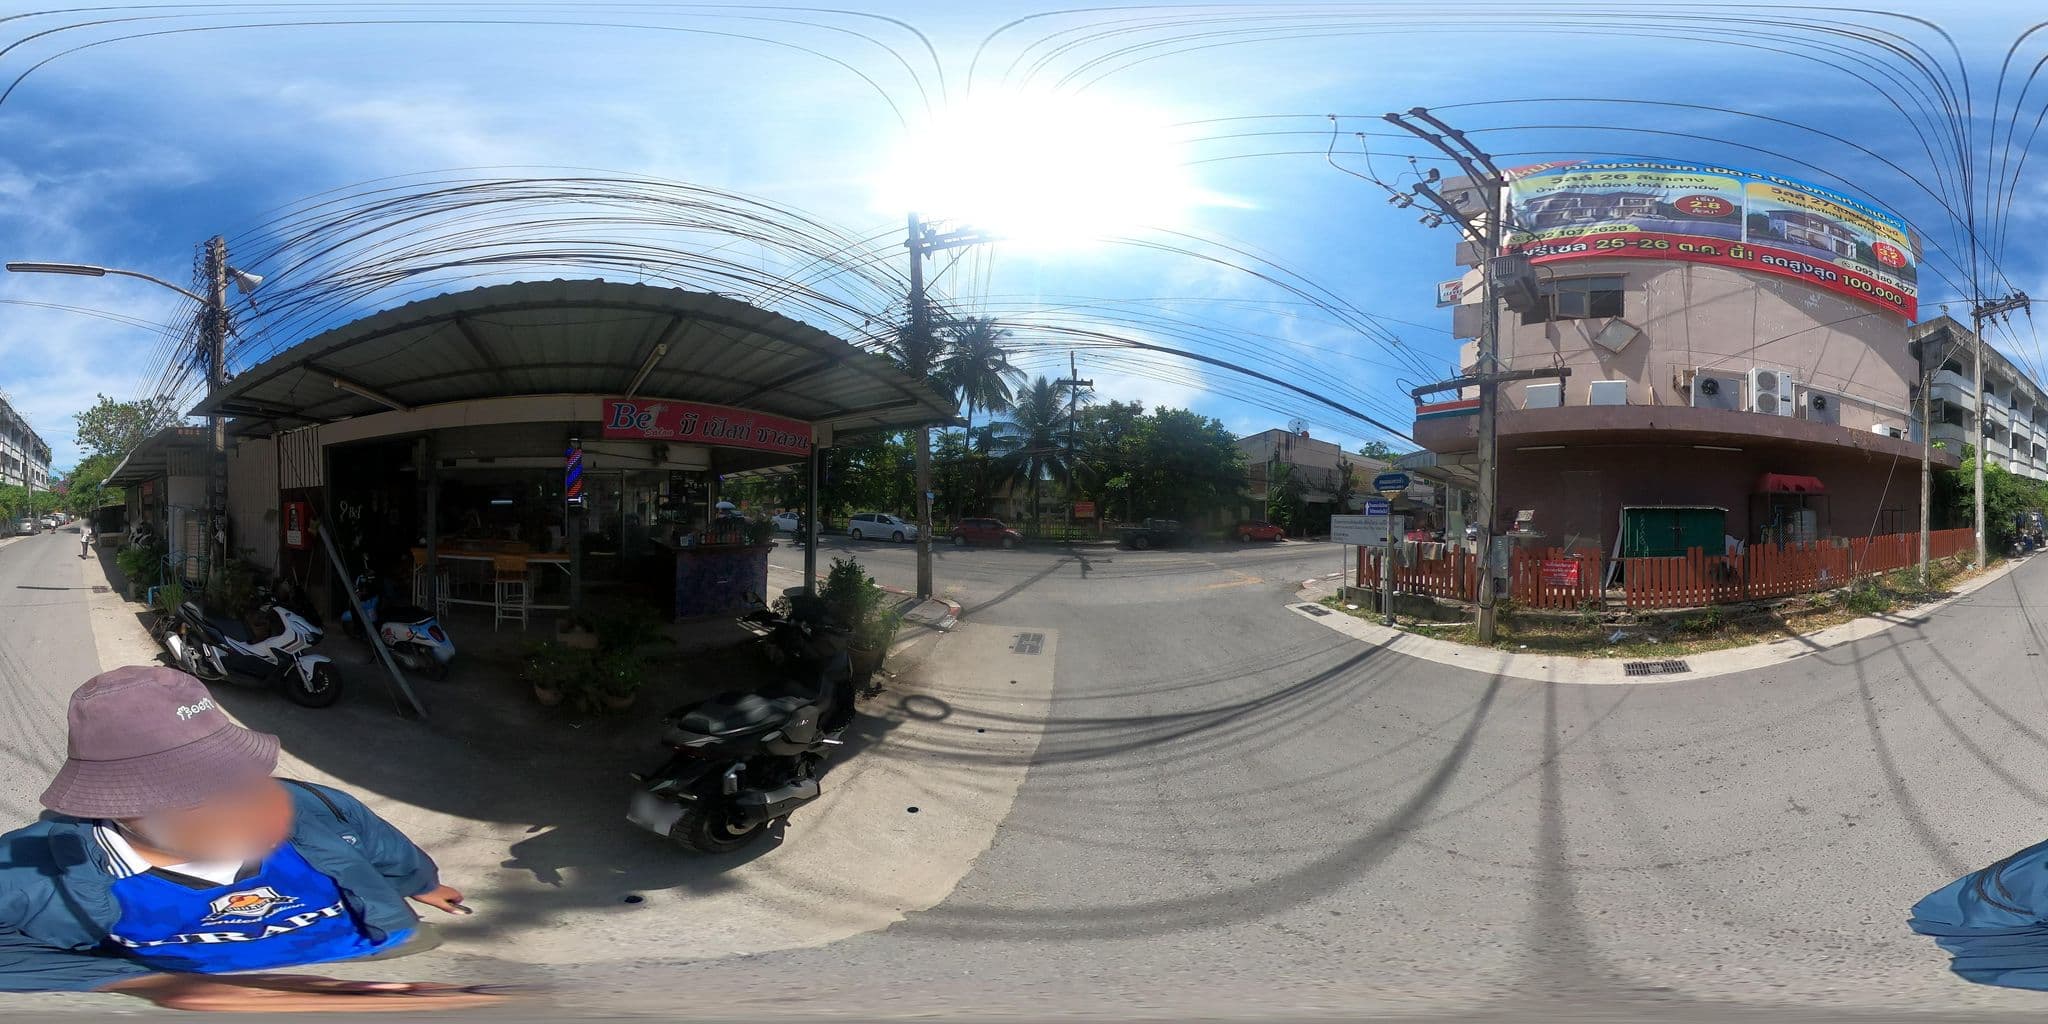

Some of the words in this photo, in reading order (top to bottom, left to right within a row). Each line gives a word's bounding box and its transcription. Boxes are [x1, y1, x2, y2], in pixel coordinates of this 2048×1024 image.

[1599, 173, 1628, 181] 26
[1689, 200, 1721, 209] 2.8
[1560, 229, 1585, 237] 107
[1596, 238, 1670, 250] 25-26
[1678, 241, 1721, 257] ต.ค.
[1761, 254, 1837, 281] ลดสูงสุด
[1855, 265, 1873, 277] 092
[1876, 273, 1893, 285] 180
